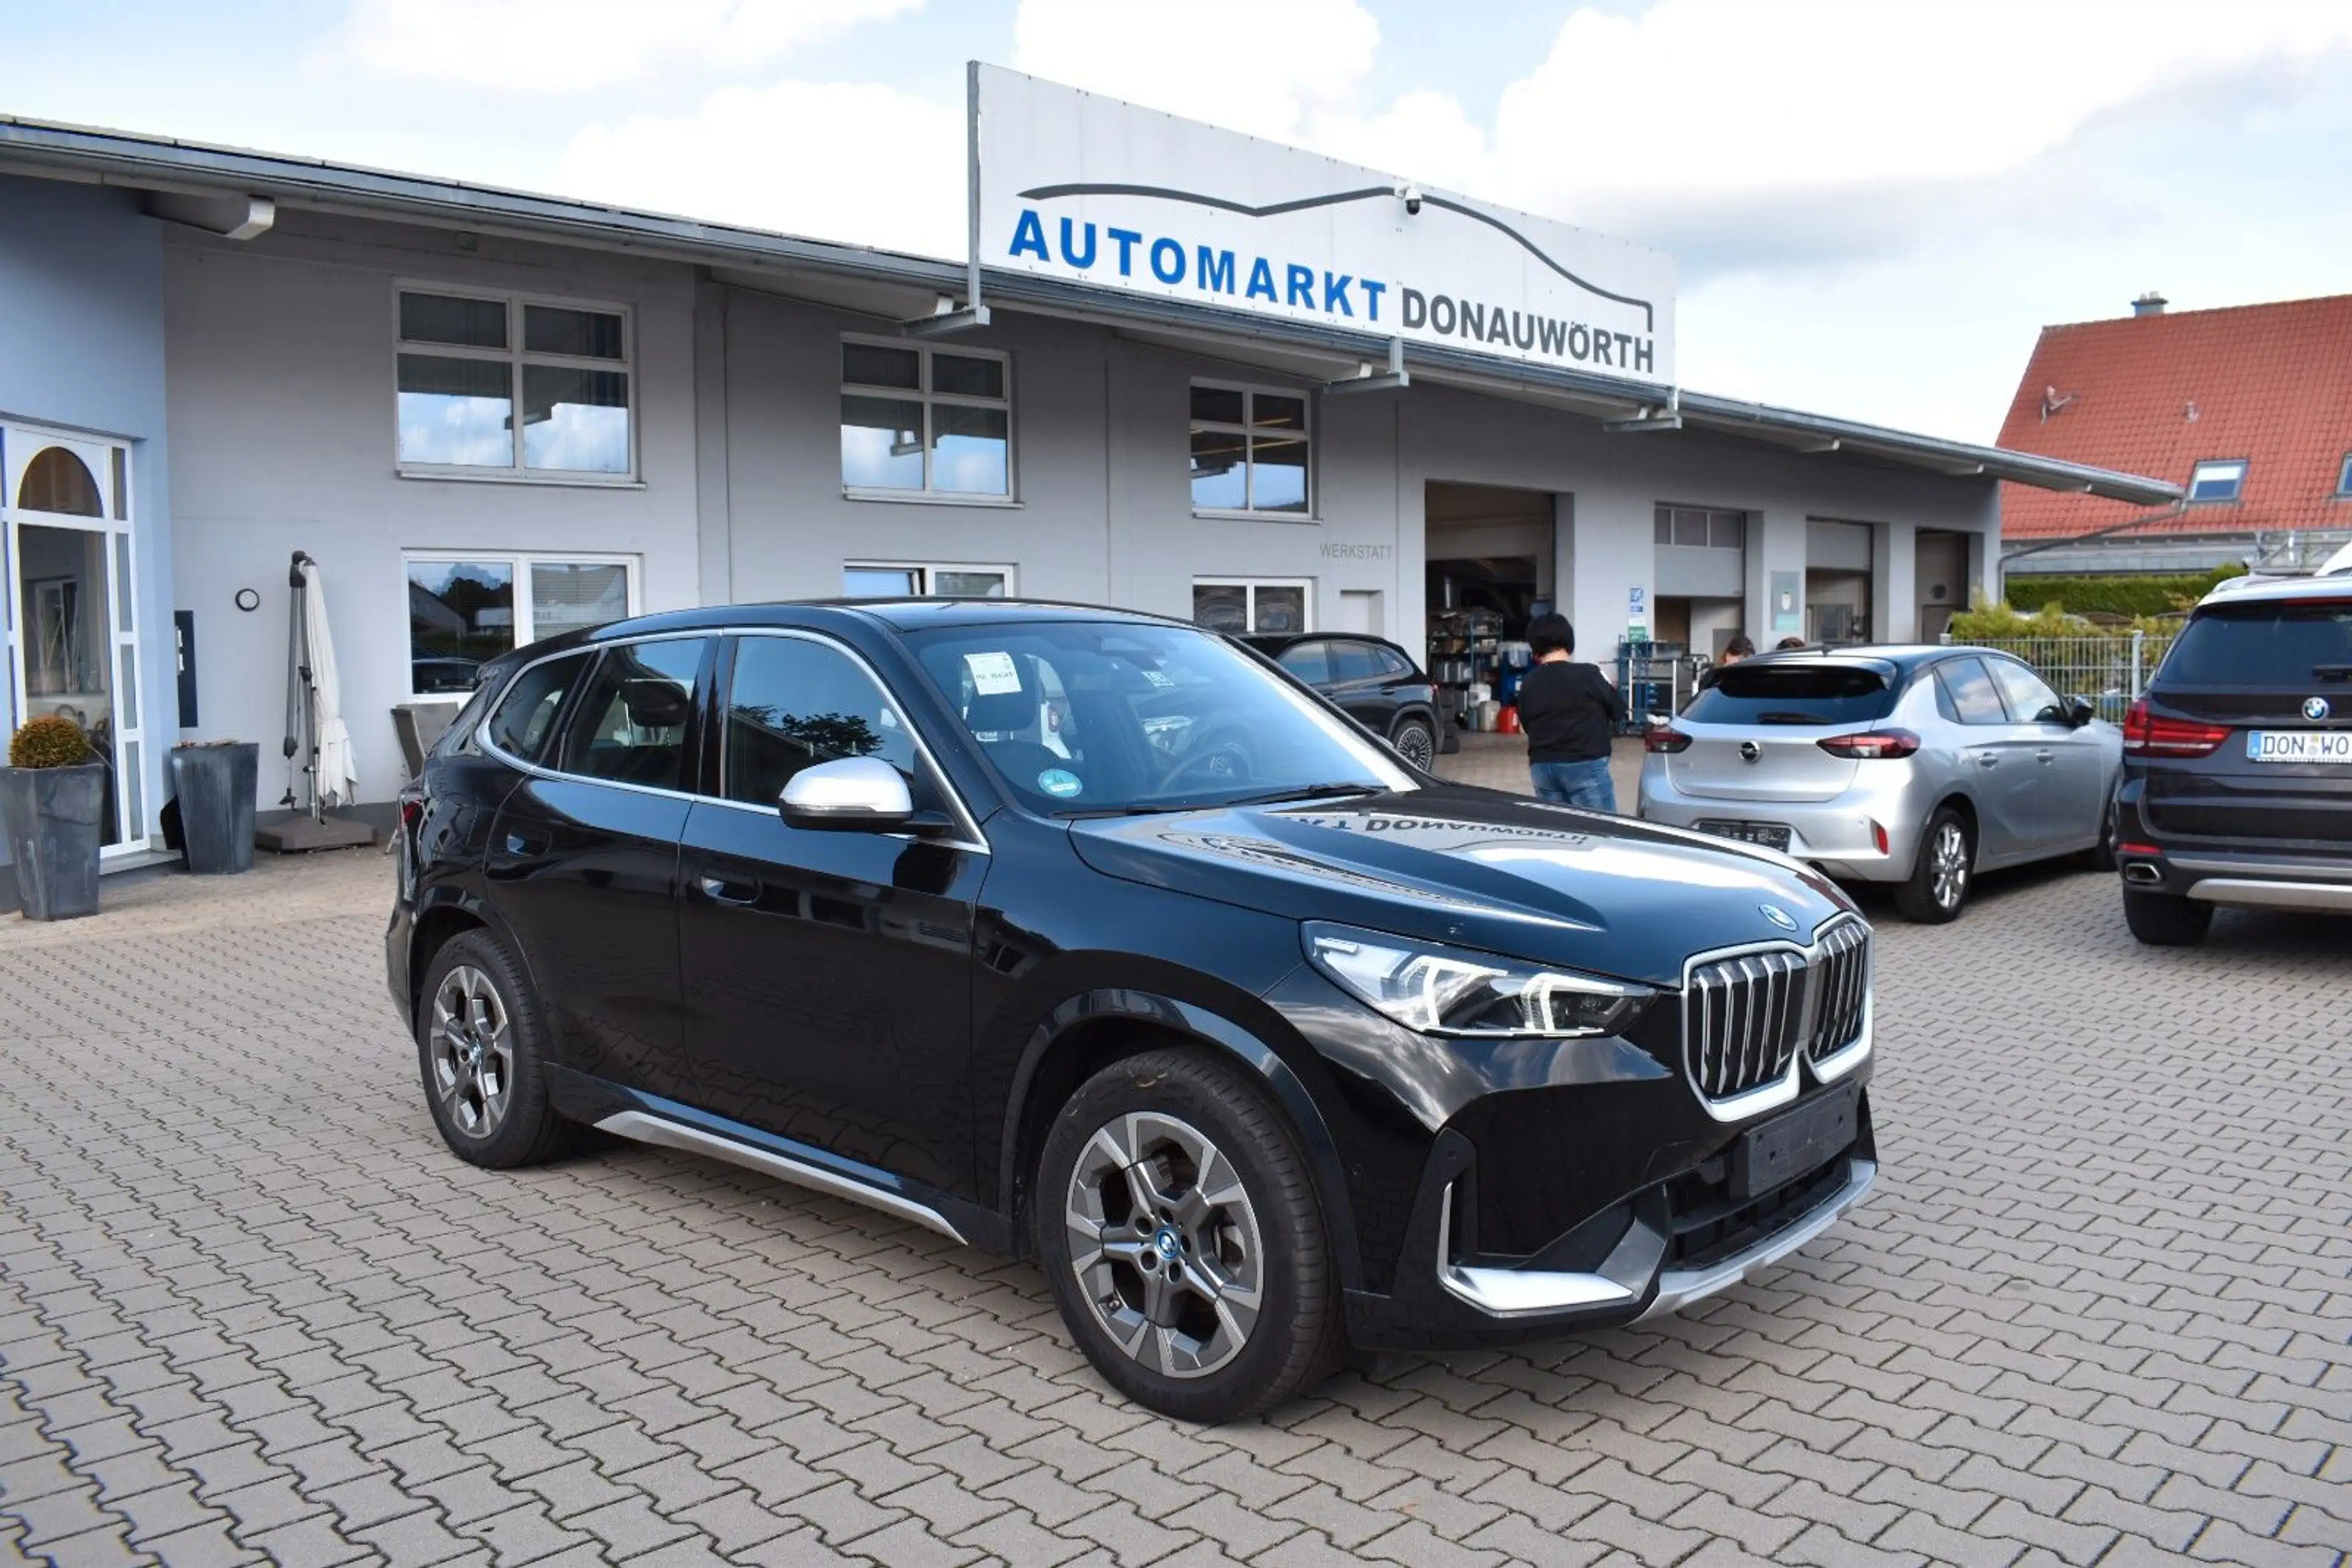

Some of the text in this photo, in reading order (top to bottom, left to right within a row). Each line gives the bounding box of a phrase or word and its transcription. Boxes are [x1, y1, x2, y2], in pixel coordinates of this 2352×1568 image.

[1009, 209, 1653, 373] AUTOMARKT DONAUWÖRTH
[1319, 543, 1392, 559] WERKSTATT
[2263, 736, 2305, 755] DON
